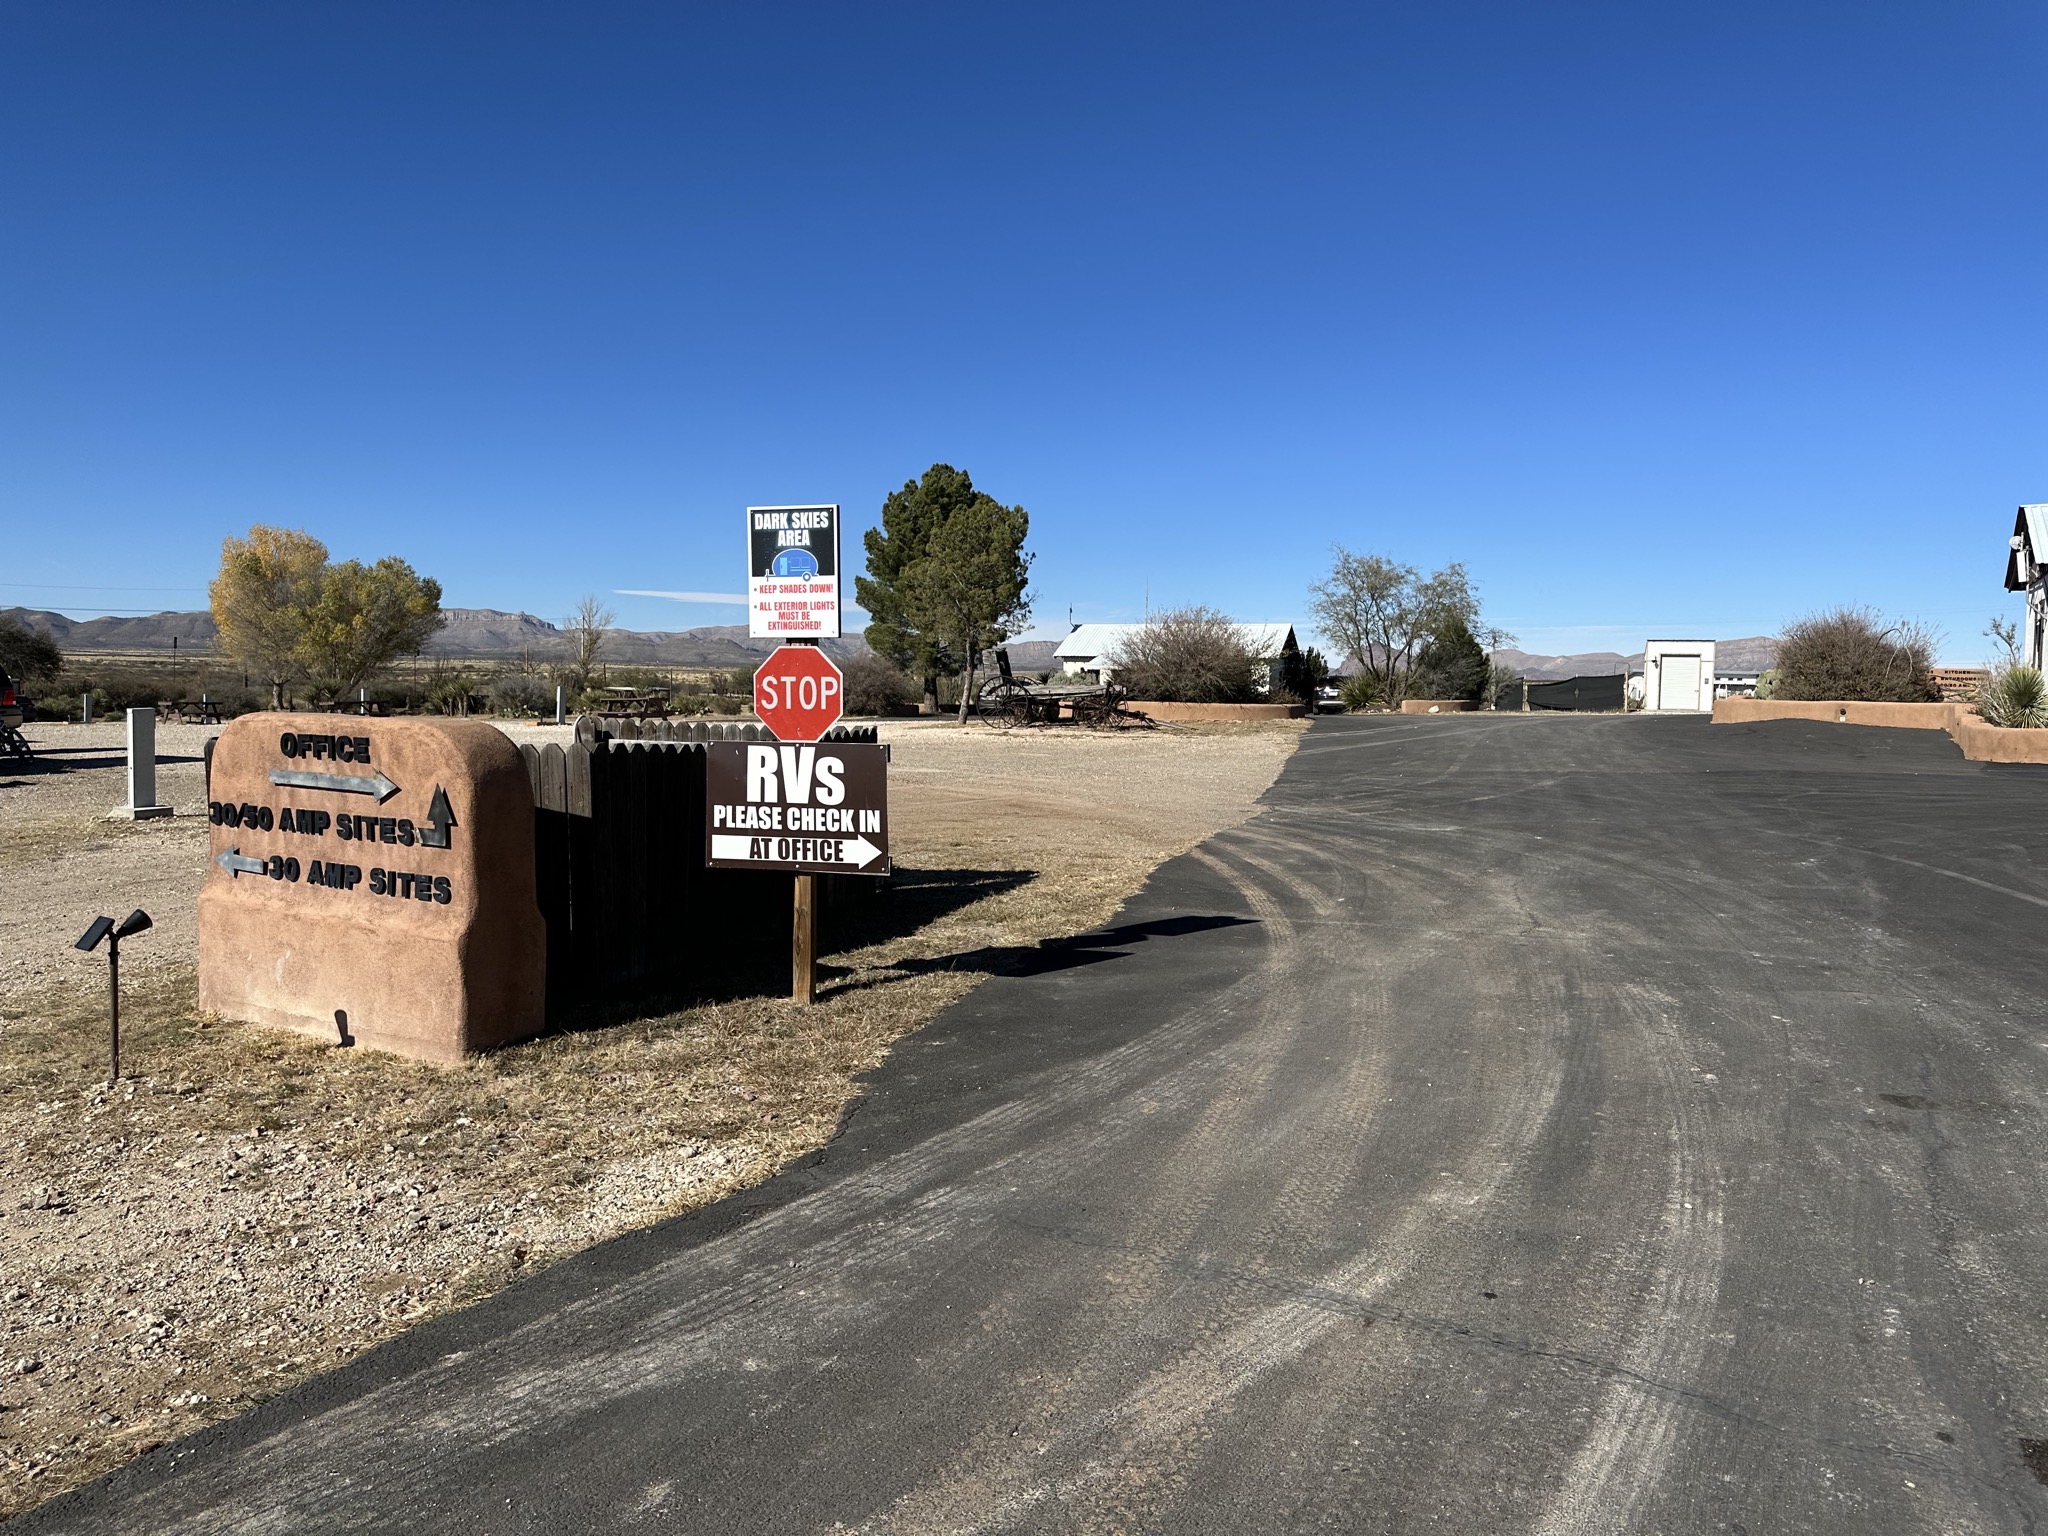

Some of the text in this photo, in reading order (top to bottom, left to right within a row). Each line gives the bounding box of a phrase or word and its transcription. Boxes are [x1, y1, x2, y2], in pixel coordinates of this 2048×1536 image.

[755, 511, 829, 530] DARK SKIES
[777, 529, 811, 546] AREA
[760, 583, 834, 594] KEEP SHADES DOWN!
[759, 601, 835, 611] ALL EXTERIOR LIGHTS
[778, 611, 811, 621] MUST BE
[768, 621, 822, 630] EXTINGUISHED!
[761, 675, 839, 711] STOP
[280, 732, 371, 764] OFFICE
[746, 745, 846, 806] RVs
[209, 801, 415, 847] 30/50 AMP SITES
[713, 804, 881, 833] PLEASE CHECK IN
[749, 837, 844, 862] AT OFFICE
[269, 855, 453, 905] 30 AMP SITES
